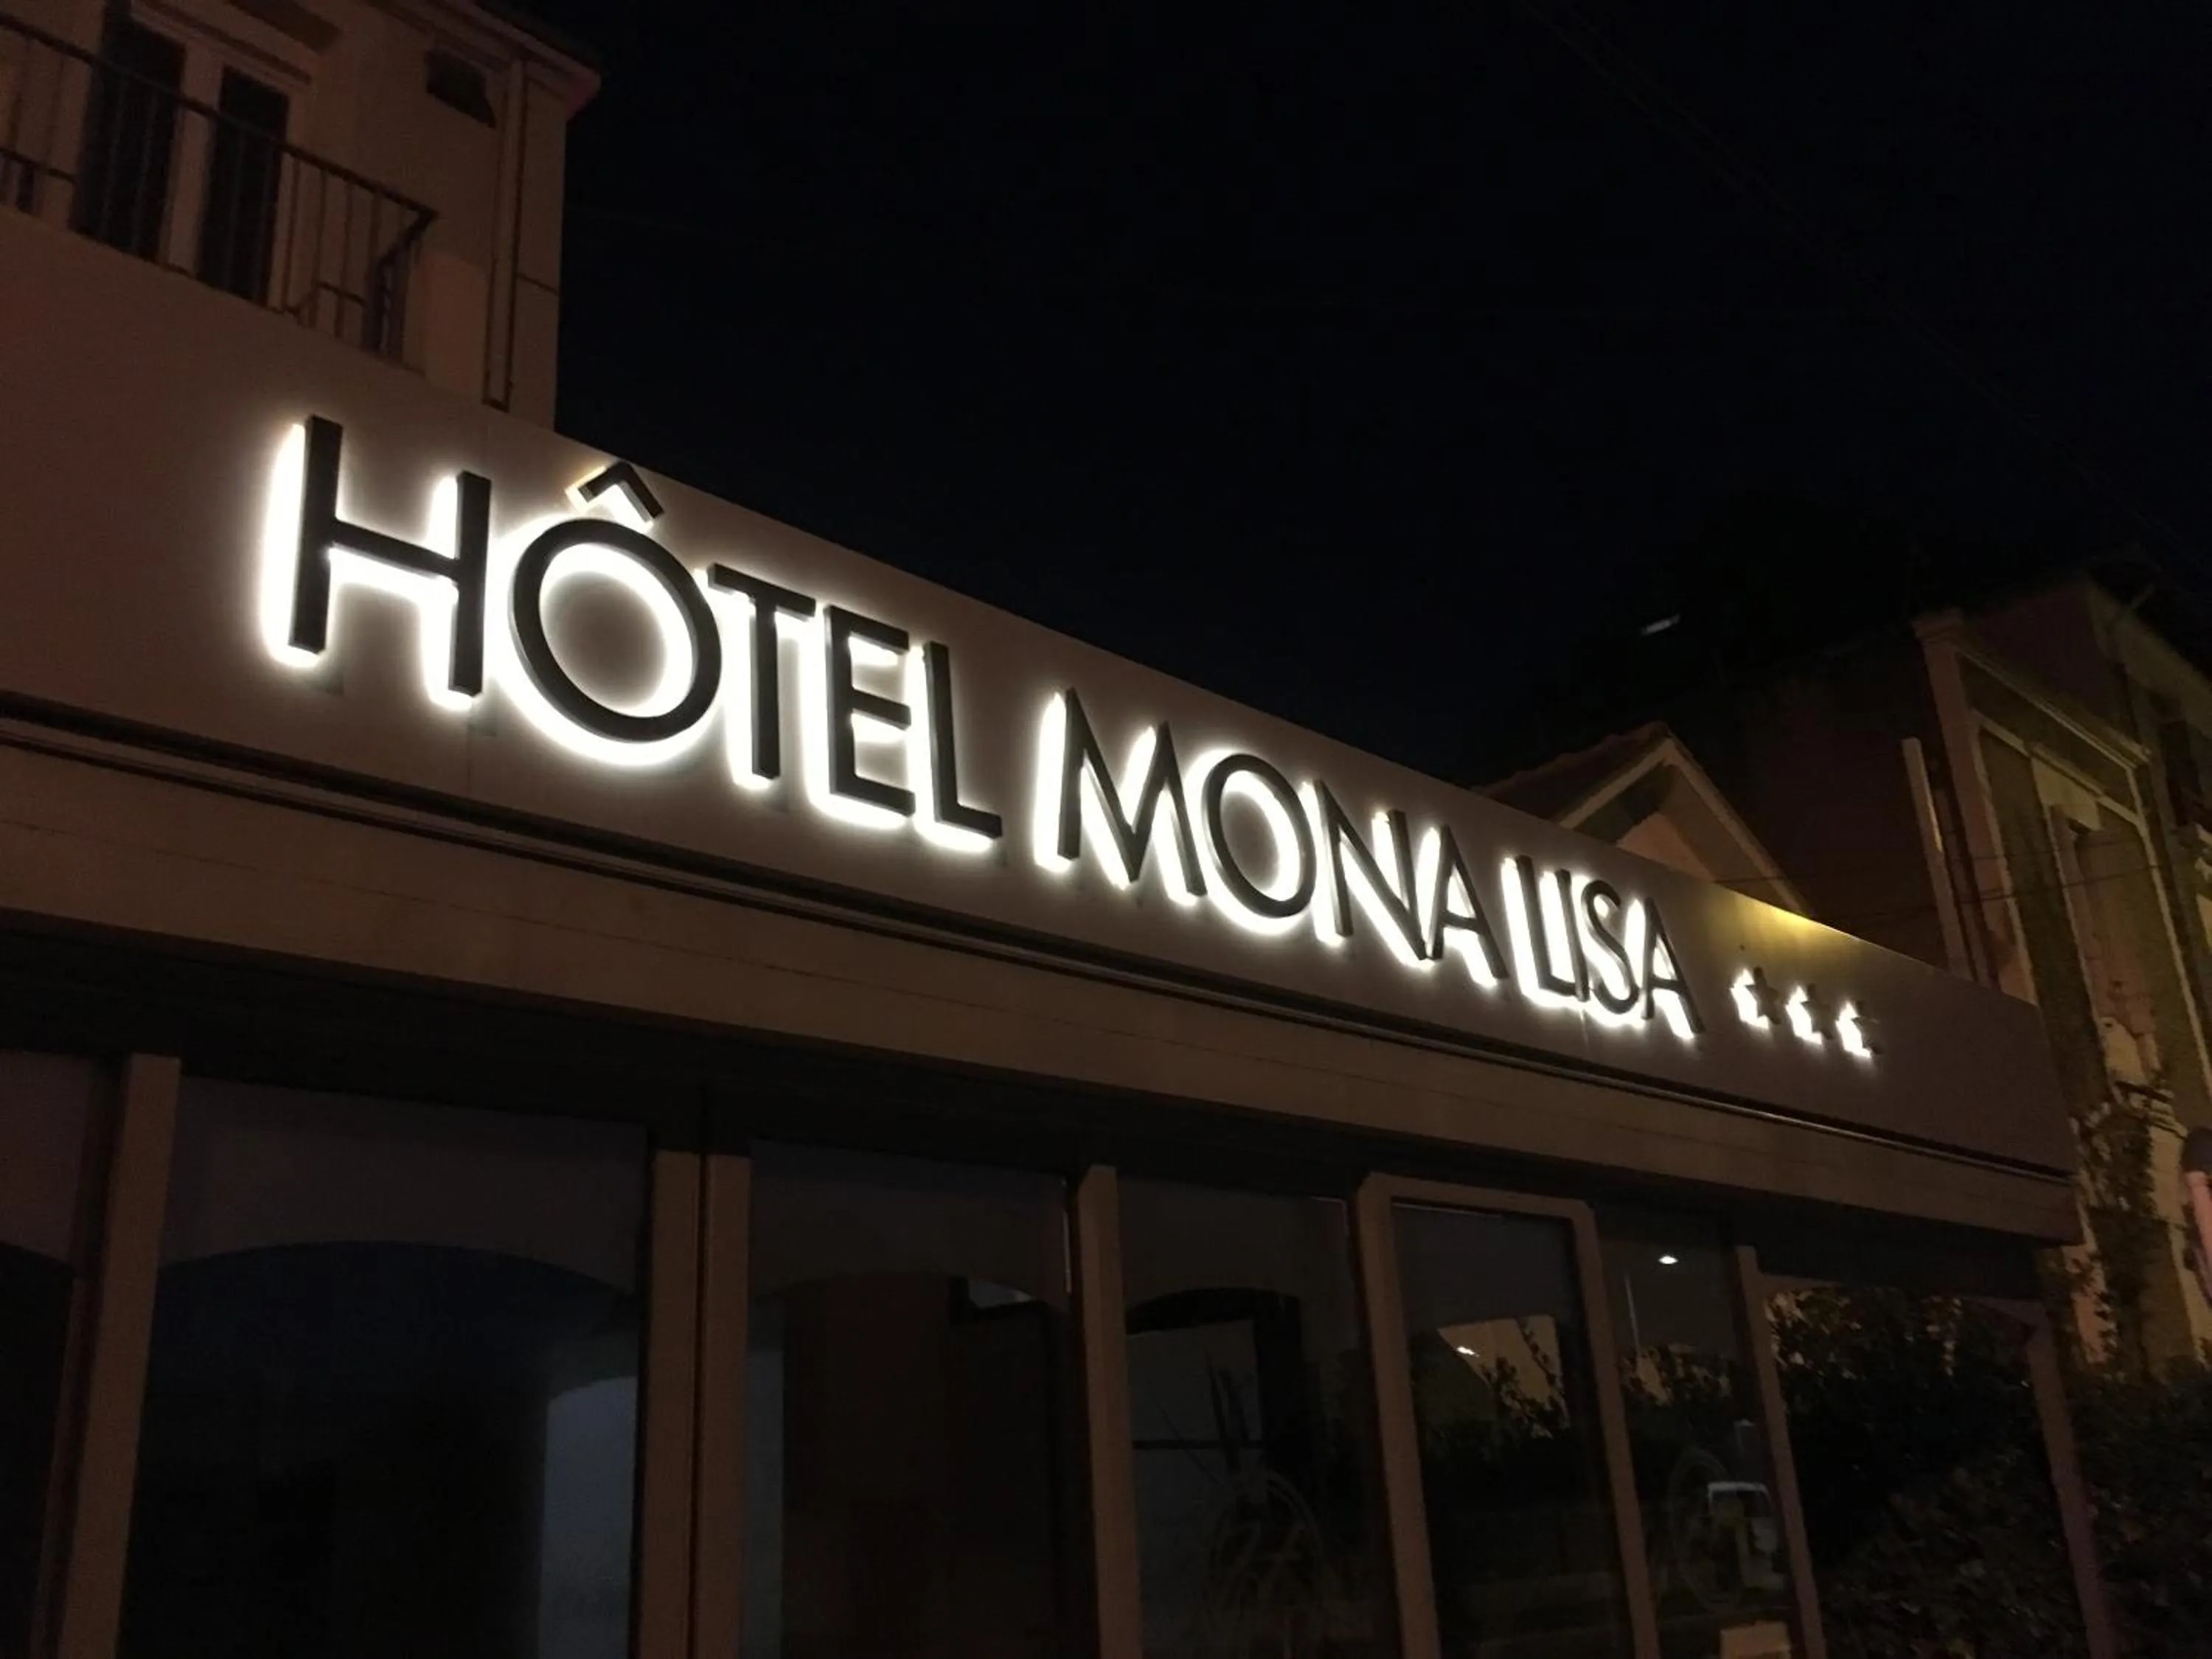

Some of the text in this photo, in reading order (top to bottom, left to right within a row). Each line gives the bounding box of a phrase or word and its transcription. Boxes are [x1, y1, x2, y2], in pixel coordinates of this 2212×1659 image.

[288, 414, 1705, 1036] HÔTEL MONA LISA
